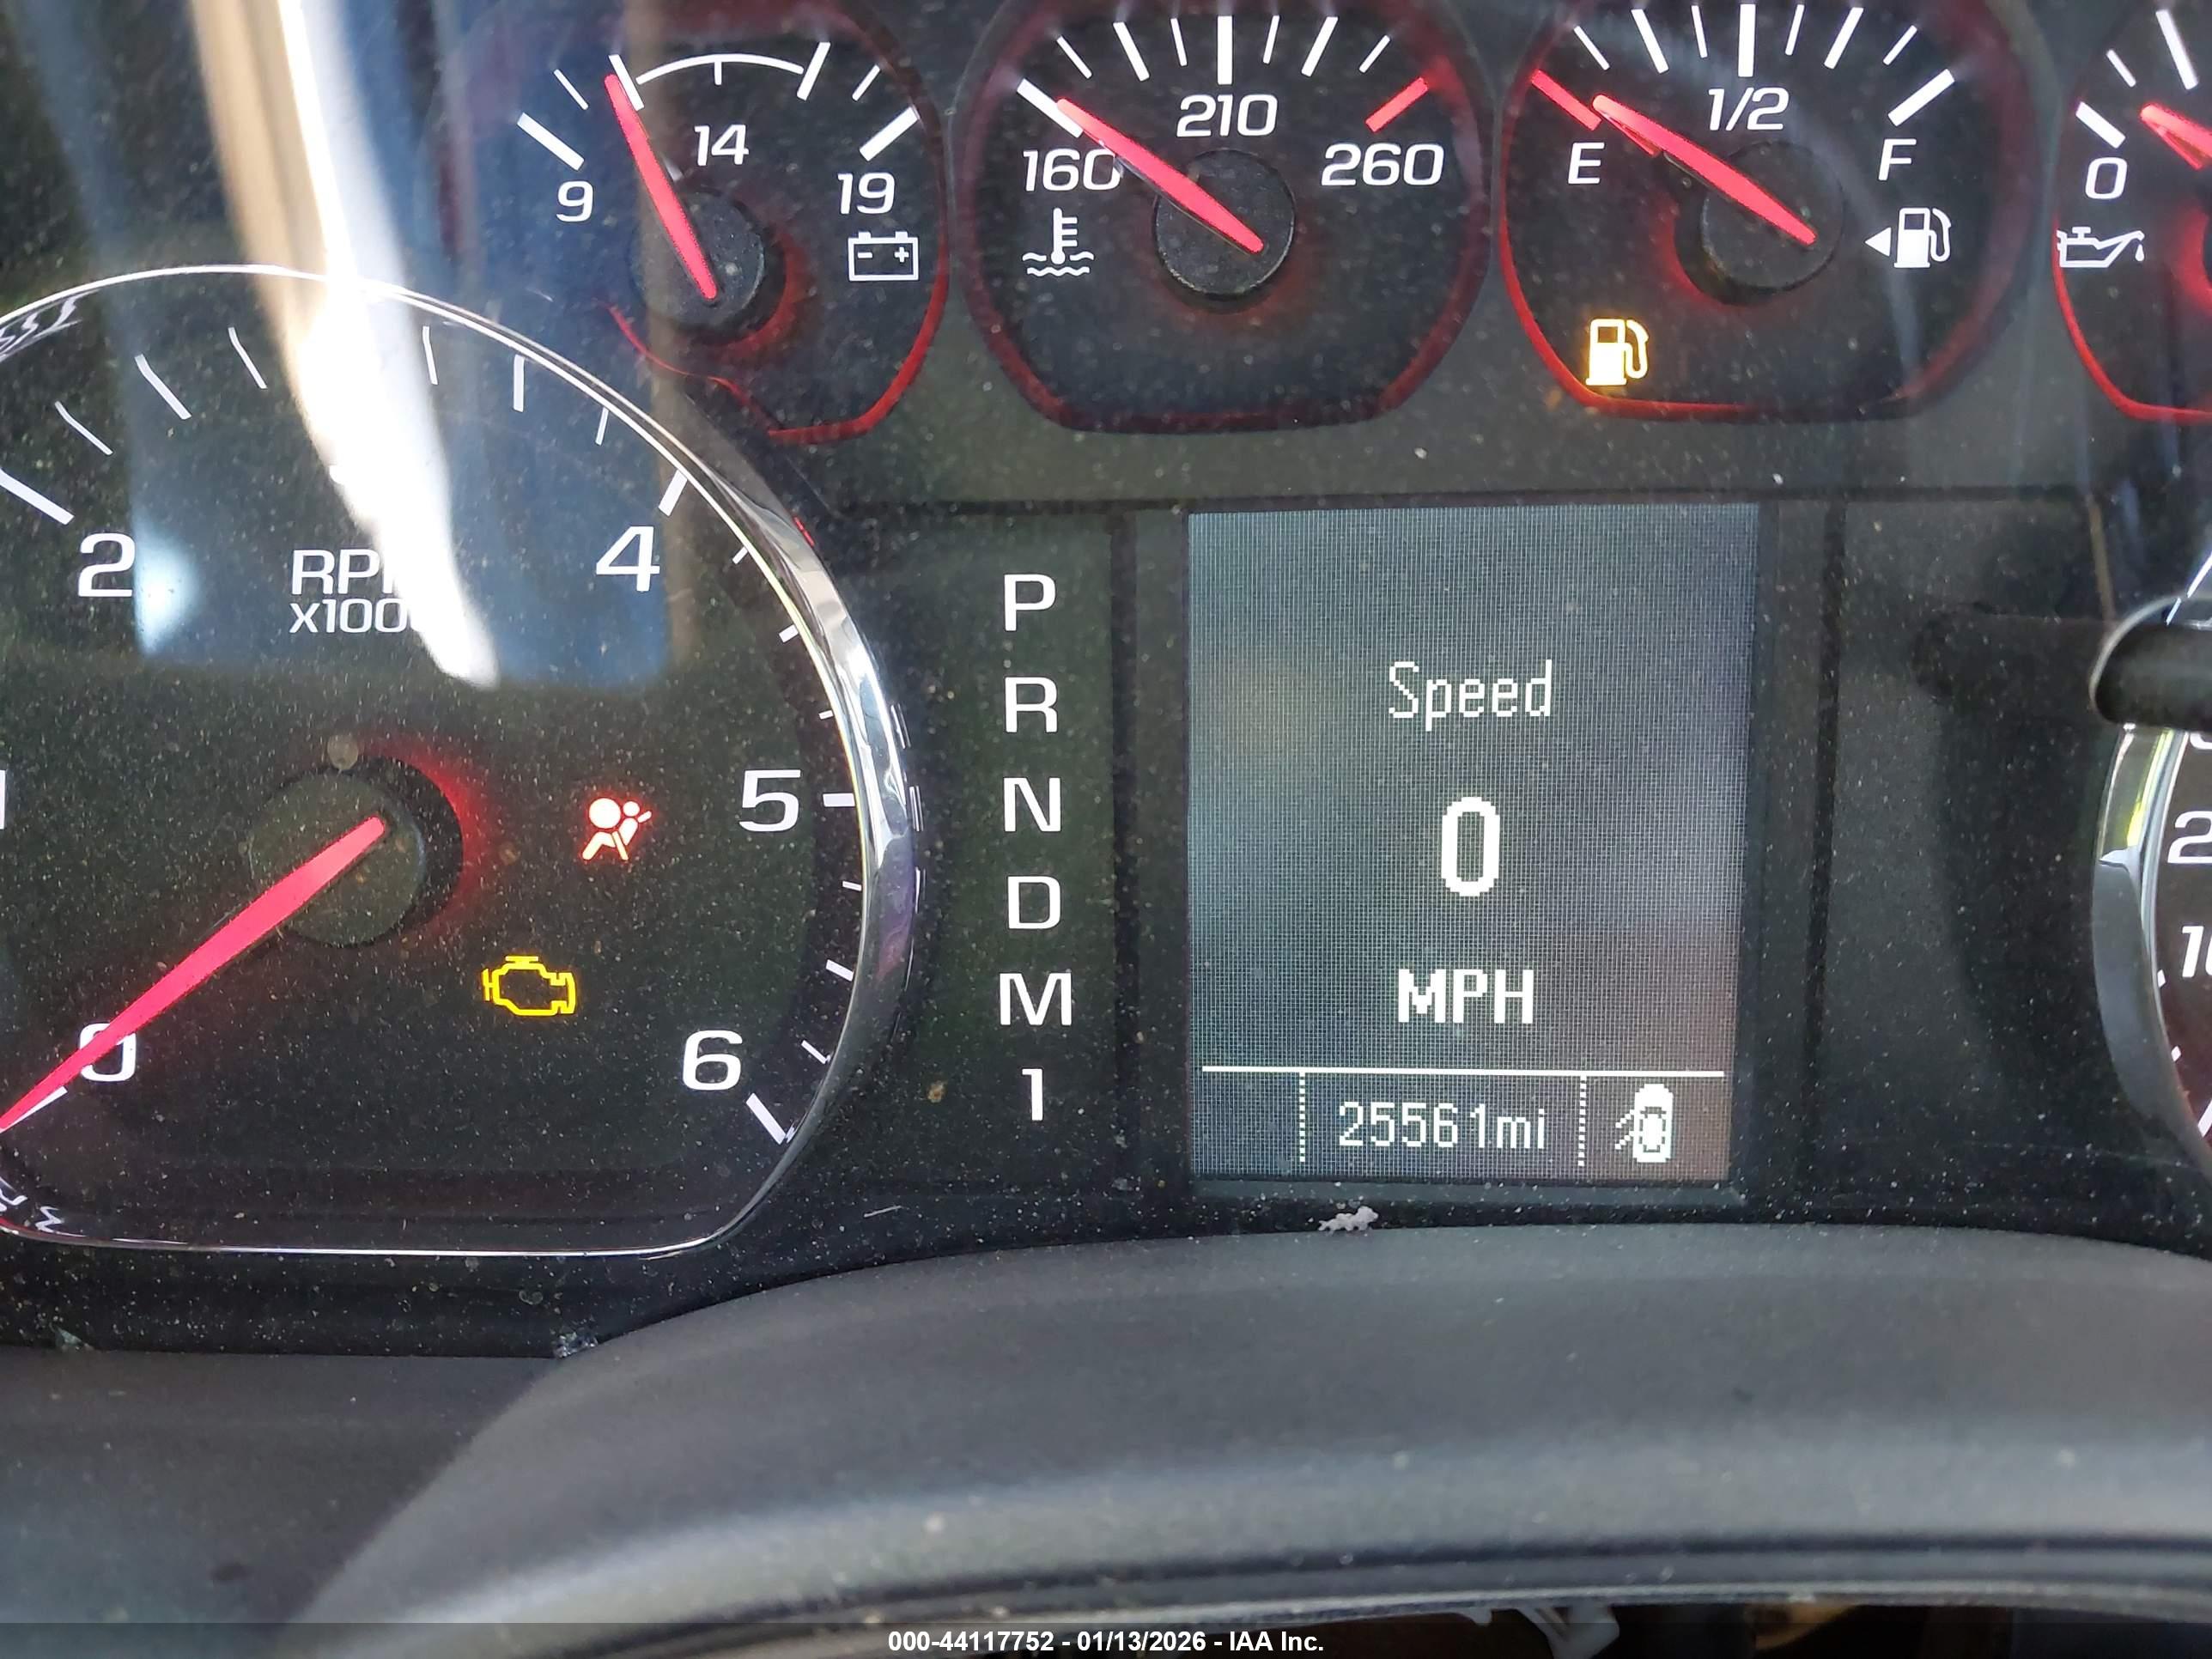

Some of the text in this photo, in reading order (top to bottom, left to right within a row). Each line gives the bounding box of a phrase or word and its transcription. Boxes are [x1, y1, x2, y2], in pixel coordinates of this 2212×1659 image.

[1176, 94, 1278, 137] 210
[1708, 87, 1790, 131] 1/2
[694, 124, 750, 167] 14
[1023, 149, 1121, 191] 160
[1321, 143, 1444, 186] 260
[1567, 142, 1605, 185] E
[1878, 138, 1917, 181] F
[556, 180, 593, 222] 9
[837, 172, 896, 215] 19
[2085, 156, 2128, 200] 0
[77, 532, 135, 598] 2
[291, 549, 400, 595] RP
[595, 526, 660, 592] 4
[289, 598, 415, 634] x100
[1004, 574, 1056, 631] P
[1005, 677, 1058, 733] R
[1388, 659, 1554, 731] Speed
[738, 769, 801, 832] 5
[1003, 777, 1061, 832] N
[1440, 796, 1502, 898] 0
[1007, 876, 1061, 930] D
[1000, 972, 1073, 1026] M
[1397, 968, 1535, 1026] MPH
[79, 1023, 137, 1082] 0
[682, 1030, 743, 1091] 6
[1022, 1068, 1043, 1121] 1
[1338, 1101, 1547, 1151] 25561mi
